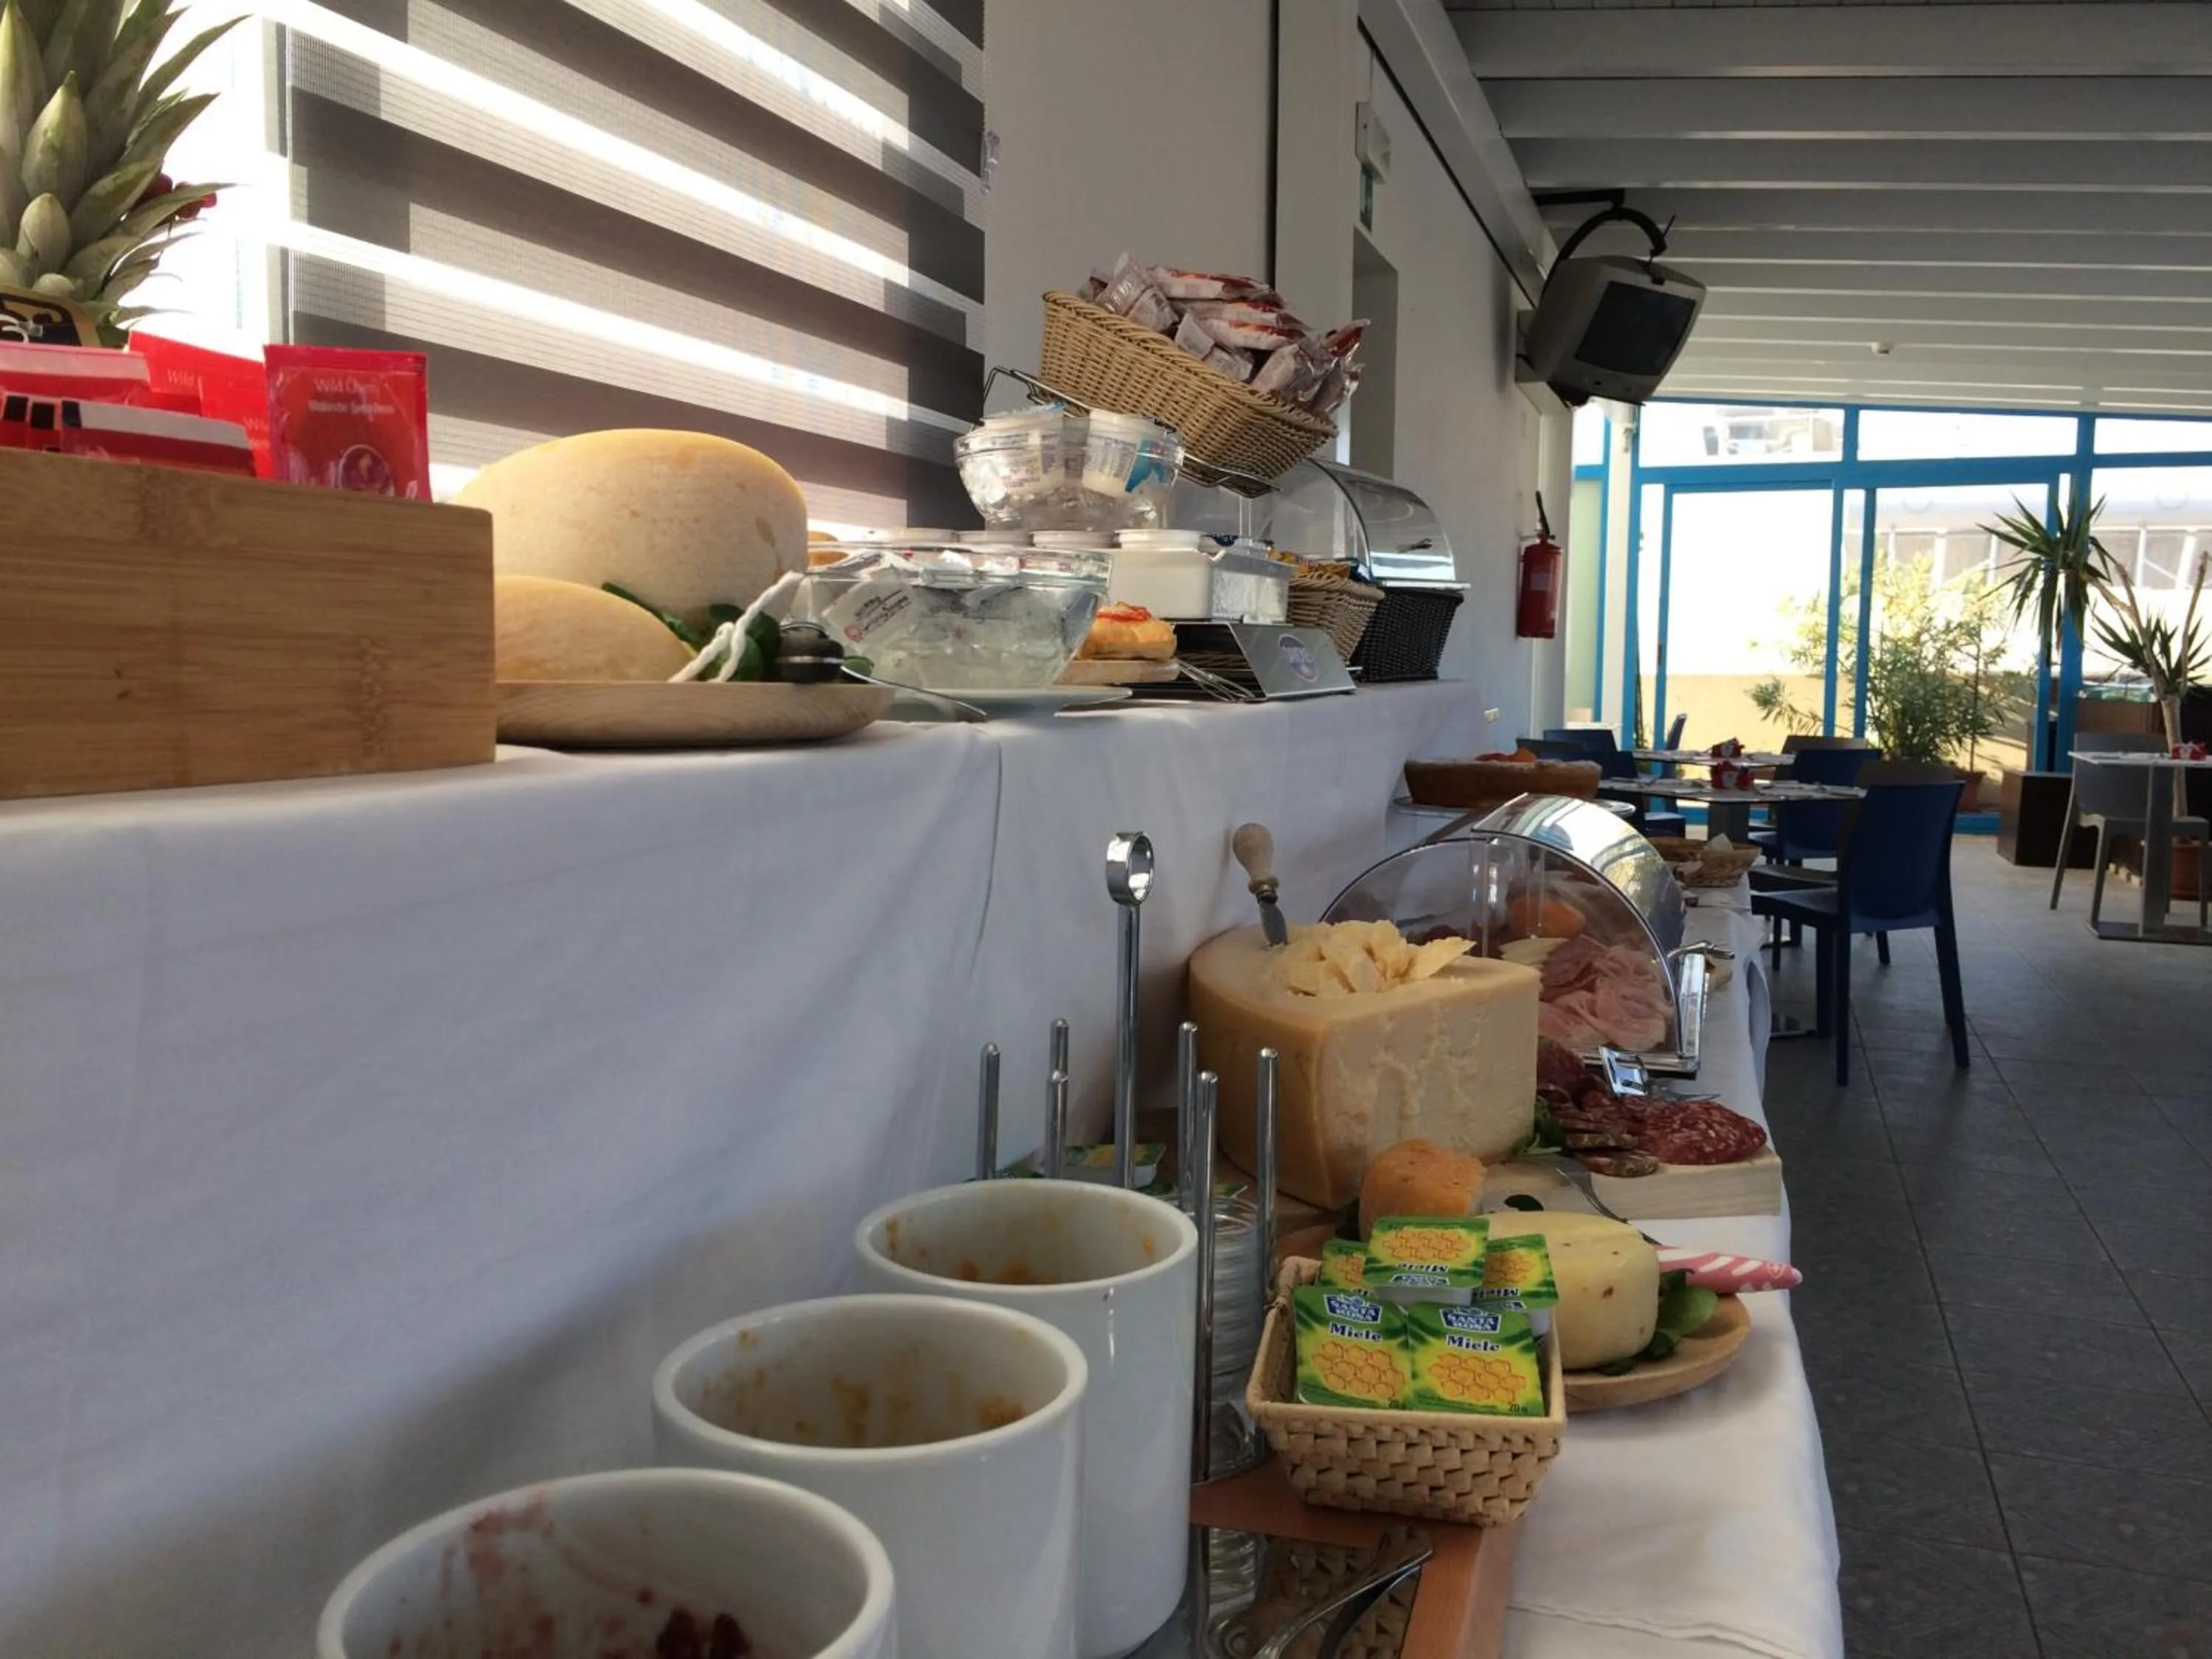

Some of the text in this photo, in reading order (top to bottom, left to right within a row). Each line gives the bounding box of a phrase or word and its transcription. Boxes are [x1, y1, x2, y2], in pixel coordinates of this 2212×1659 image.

[167, 369, 194, 388] Wild
[313, 378, 343, 392] Wild
[1330, 1300, 1376, 1316] SANTA
[1447, 1313, 1495, 1325] SANTA
[1329, 1323, 1382, 1343] Miele
[1446, 1335, 1500, 1352] Miele
